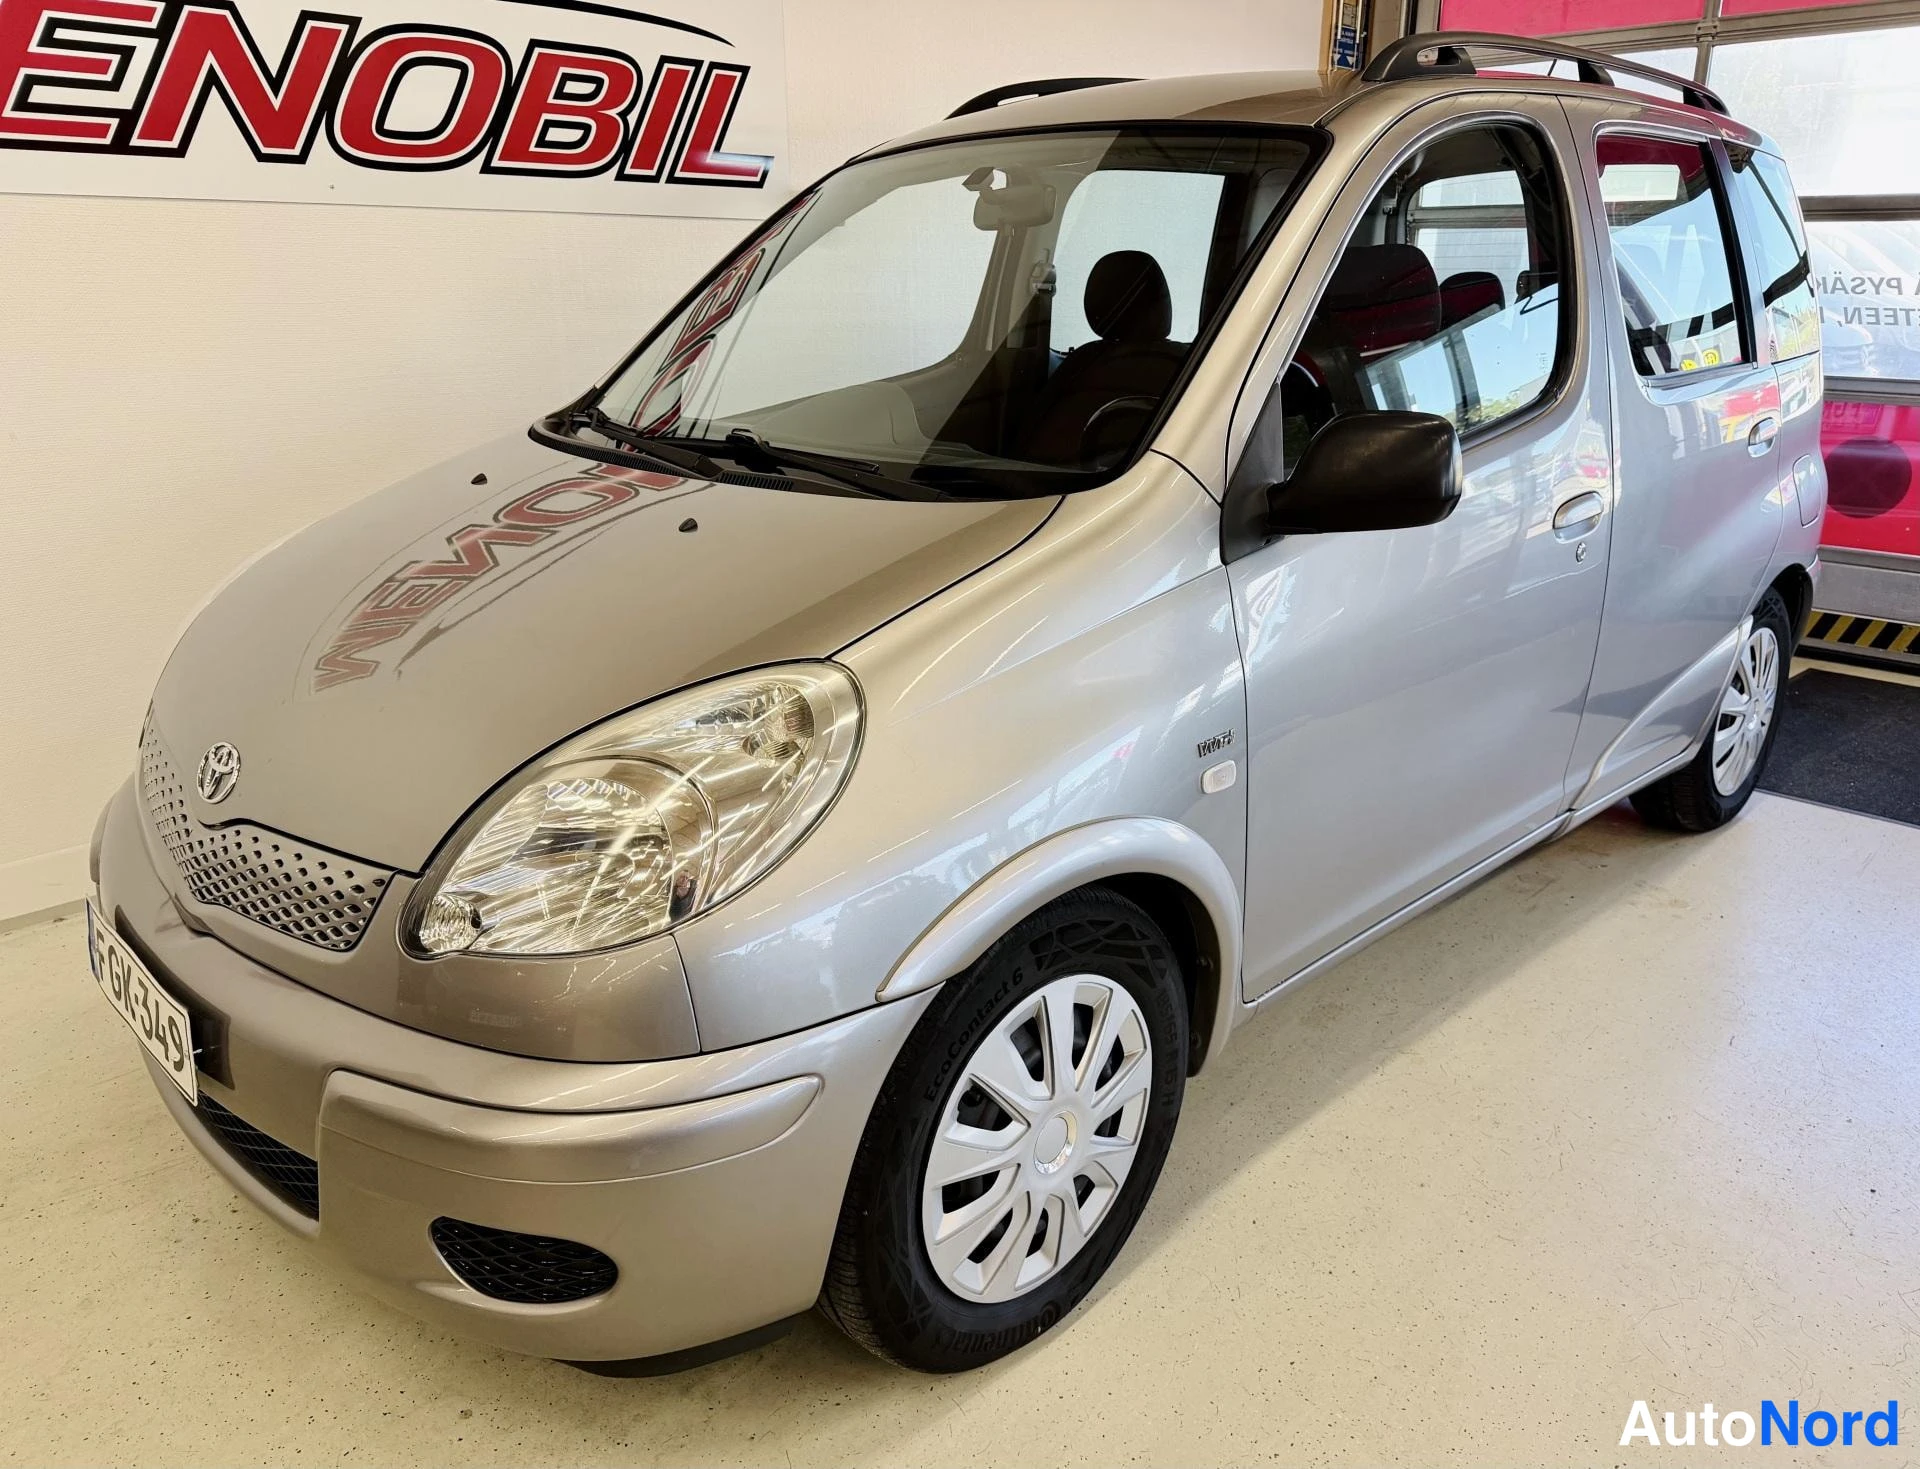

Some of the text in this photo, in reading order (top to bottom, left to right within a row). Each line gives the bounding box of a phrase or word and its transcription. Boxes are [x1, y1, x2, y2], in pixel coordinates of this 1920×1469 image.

[96, 927, 185, 1073] FGK-349
[924, 967, 1024, 1101] EcoContact 6
